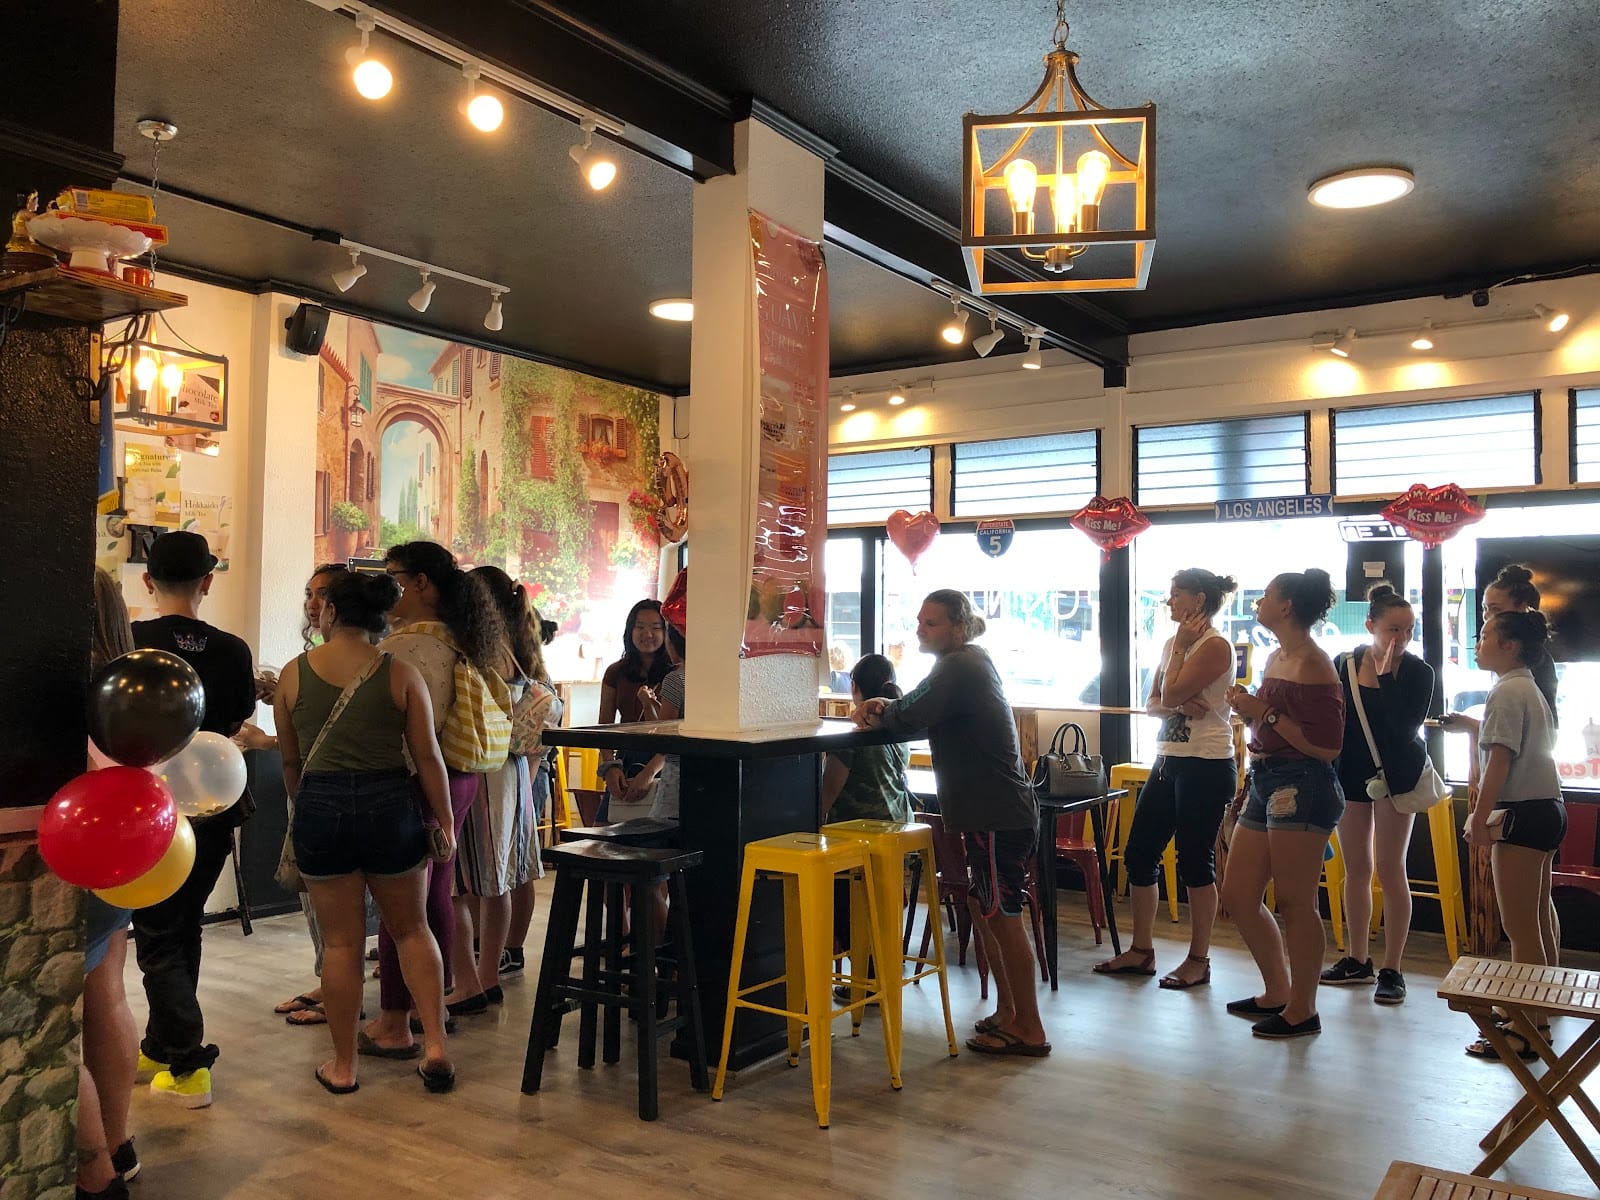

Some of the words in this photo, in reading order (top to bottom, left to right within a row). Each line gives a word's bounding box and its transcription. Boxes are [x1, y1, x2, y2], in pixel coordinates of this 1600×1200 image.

[759, 299, 811, 337] GUAVA
[179, 383, 219, 402] hocolate
[185, 499, 219, 509] Hokkaido
[1225, 502, 1252, 519] LOS
[1255, 497, 1322, 518] ANGELES
[1084, 516, 1102, 530] Kiss
[1103, 520, 1122, 531] Me!
[1407, 508, 1432, 523] Kiss
[1434, 511, 1457, 524] Me!
[989, 535, 1002, 555] 5
